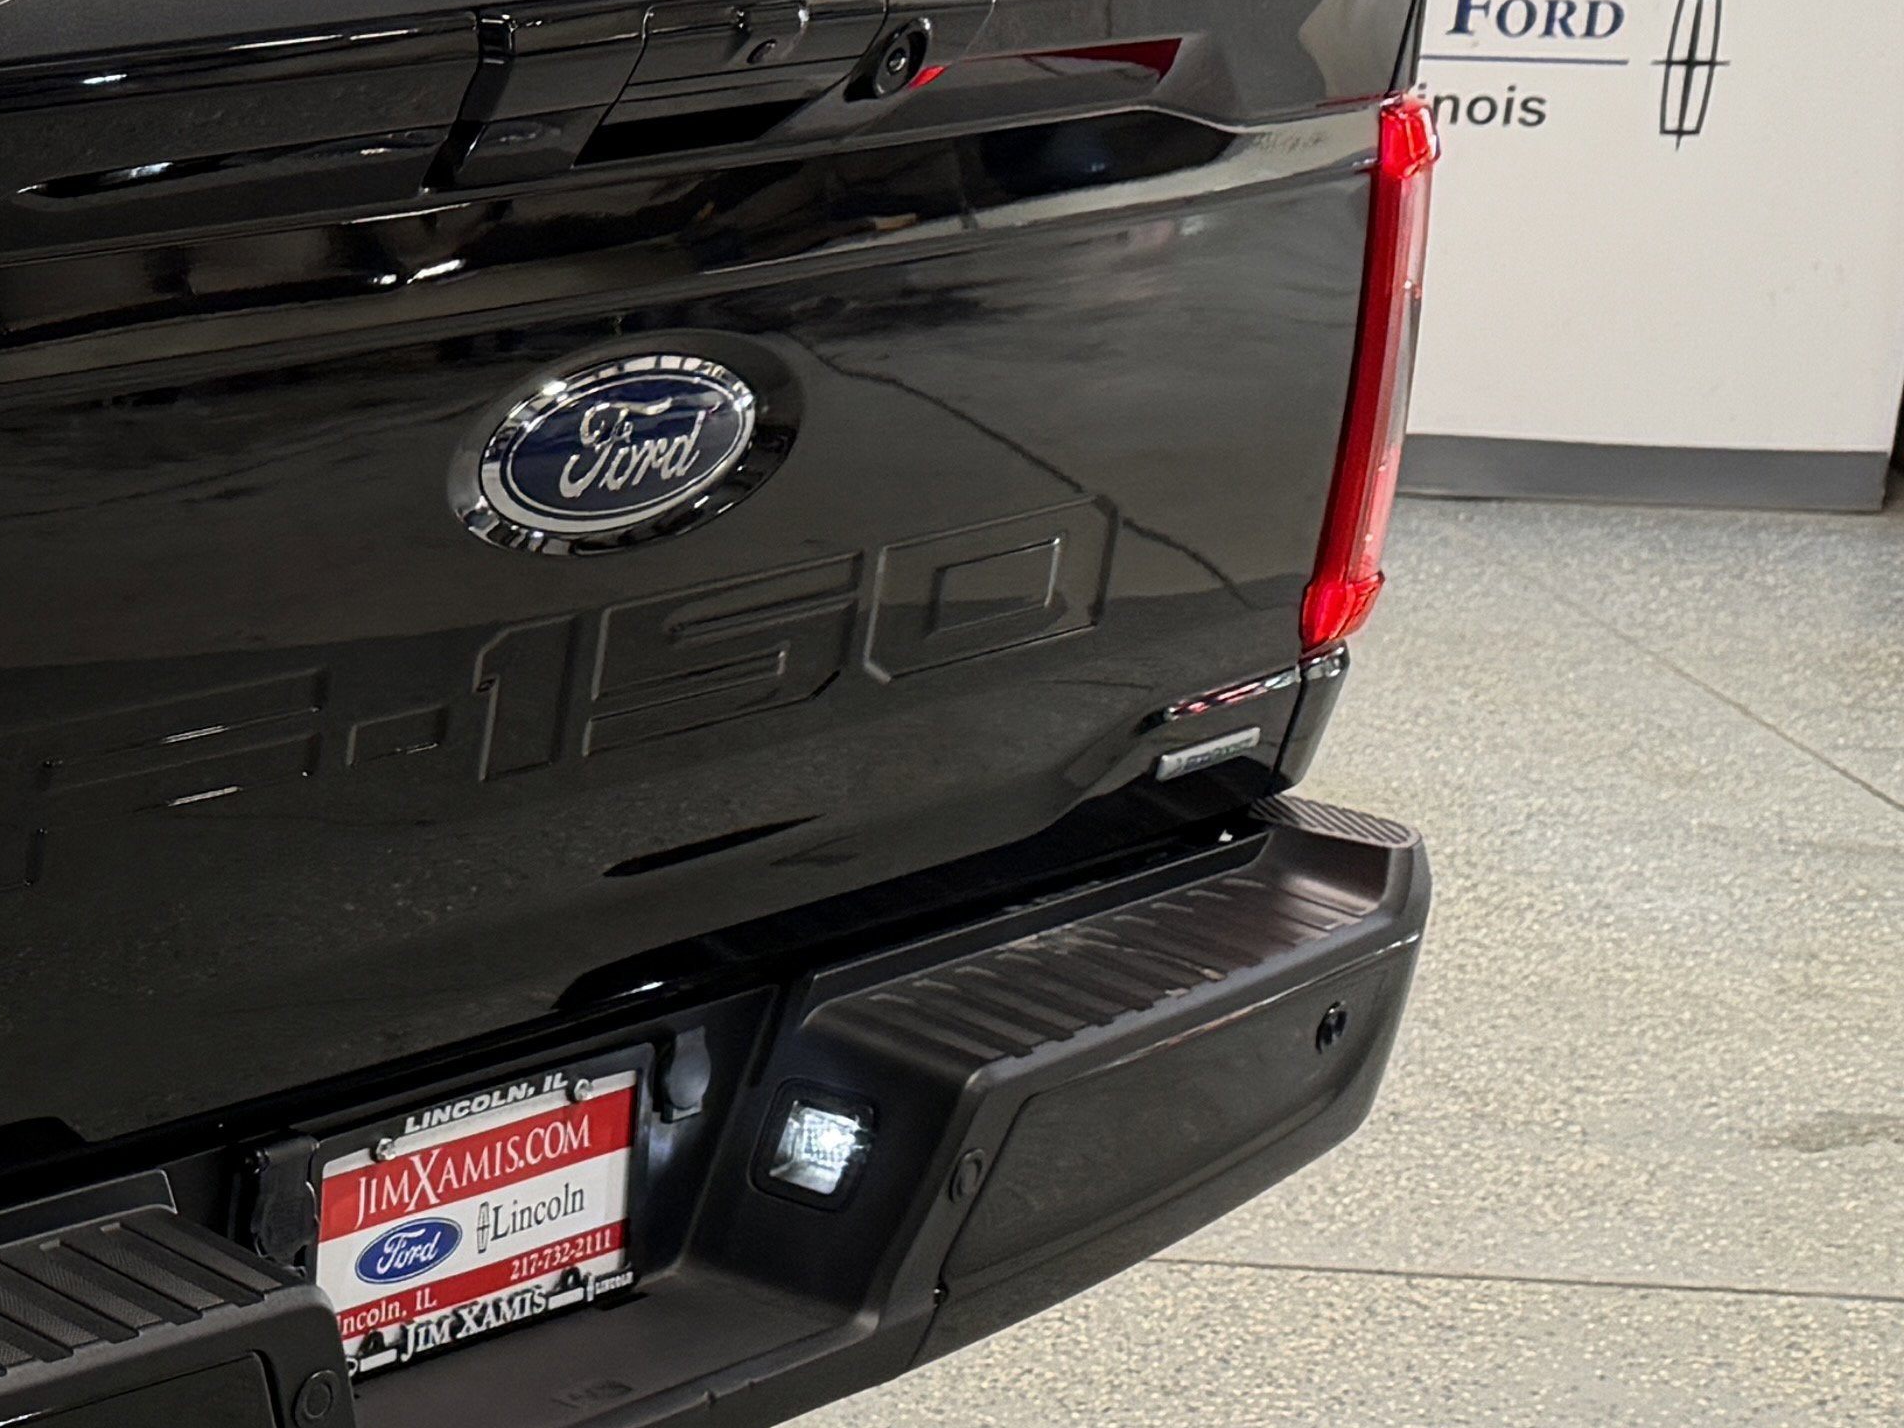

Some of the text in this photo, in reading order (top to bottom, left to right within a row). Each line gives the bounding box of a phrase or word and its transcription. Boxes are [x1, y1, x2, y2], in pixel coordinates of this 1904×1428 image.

[558, 397, 708, 499] Ford
[405, 1073, 568, 1135] LINCOLN, IL
[491, 1182, 585, 1241] Lincoln
[376, 1228, 439, 1274] Ford
[510, 1228, 612, 1282] 217-732-2111
[402, 1289, 547, 1361] JIM XAMIS
[415, 1290, 437, 1309] IL
